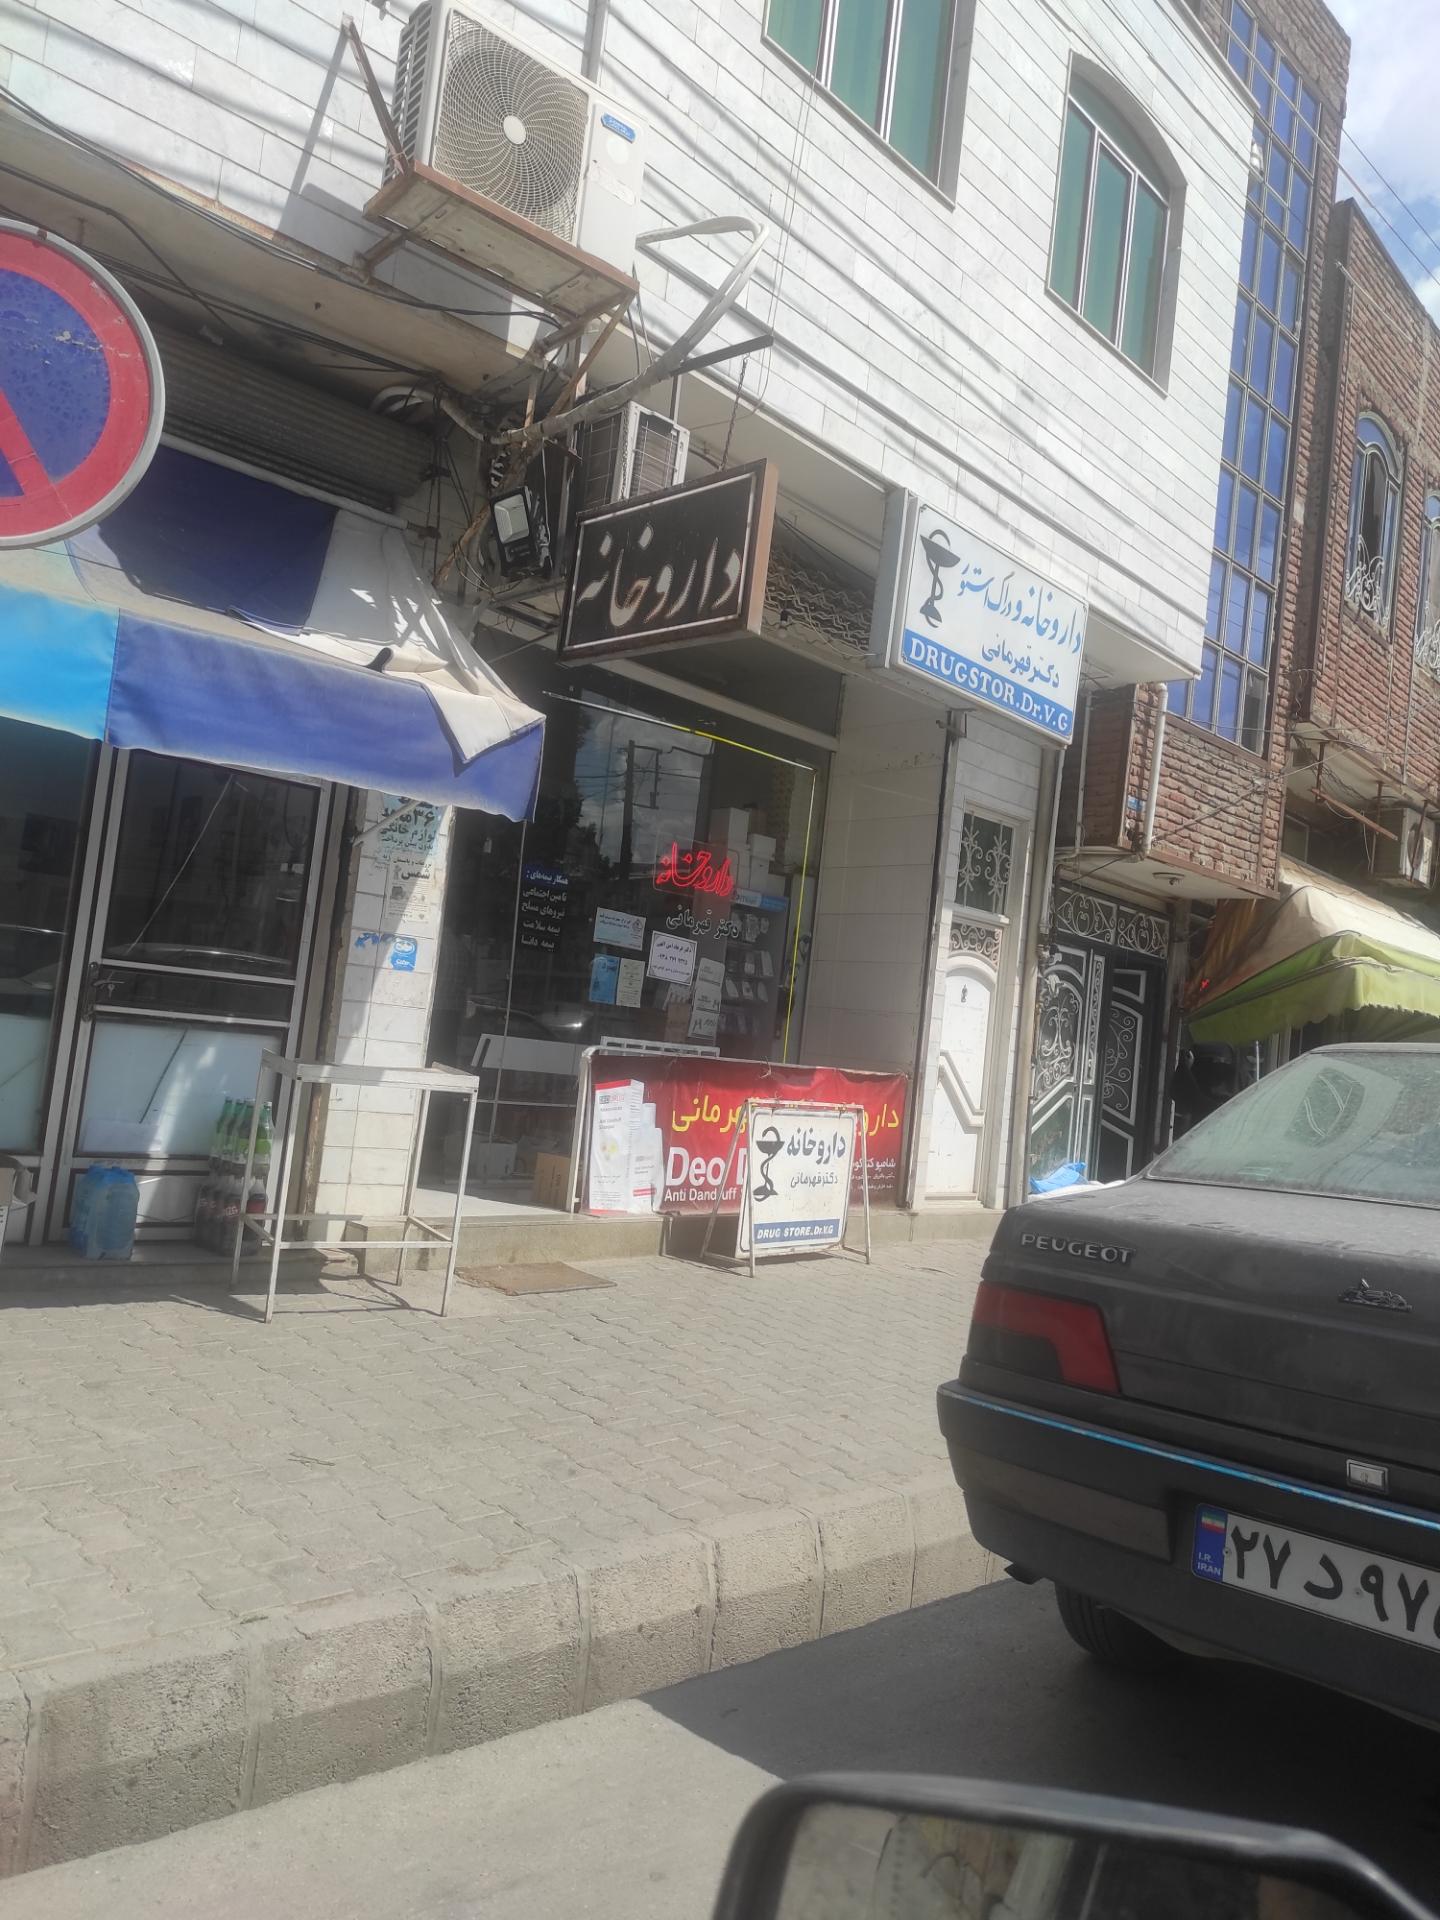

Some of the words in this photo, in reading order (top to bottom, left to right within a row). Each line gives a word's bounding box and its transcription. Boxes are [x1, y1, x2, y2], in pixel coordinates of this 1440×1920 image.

[576, 521, 742, 628] داروخانه
[1020, 584, 1082, 654] داروخانه
[981, 632, 1033, 676] قهرمانی
[1027, 654, 1061, 689] دکتر
[655, 840, 735, 898] داروخانه
[665, 904, 713, 935] قهرمانی
[713, 917, 741, 940] دکتر
[786, 1127, 846, 1166] داروخانه
[665, 1146, 726, 1187] Deo
[790, 1171, 823, 1188] قهرمانی
[821, 1171, 838, 1188] دکتر
[664, 1187, 687, 1202] Anti
[689, 1186, 738, 1202] Danduff
[756, 1228, 781, 1240] DRUG
[1020, 1232, 1134, 1265] PEUGEOT
[1197, 1561, 1222, 1577] IRAN
